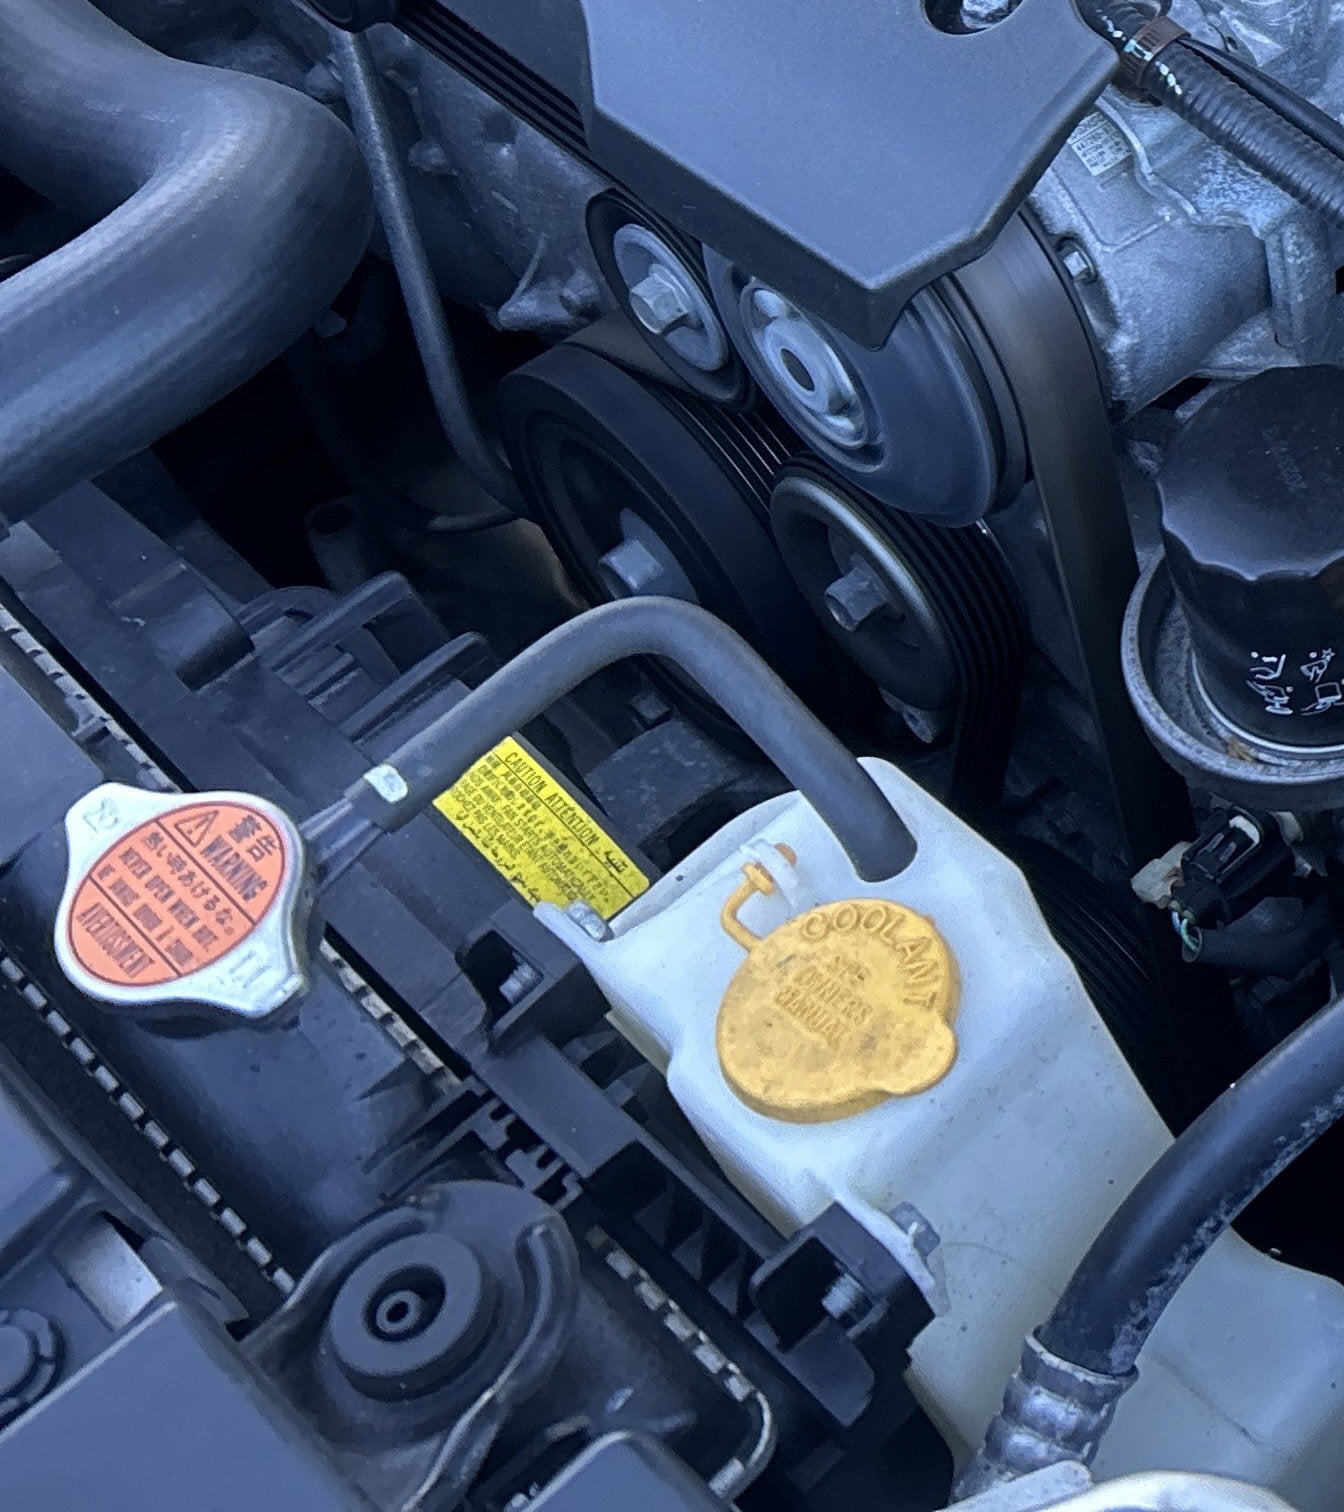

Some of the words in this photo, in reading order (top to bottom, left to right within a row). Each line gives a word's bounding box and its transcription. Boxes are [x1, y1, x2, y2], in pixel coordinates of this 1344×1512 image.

[504, 750, 547, 794] CAUTION
[200, 834, 267, 903] WARNING
[229, 813, 280, 865] 警告
[802, 902, 941, 1011] COOLANT
